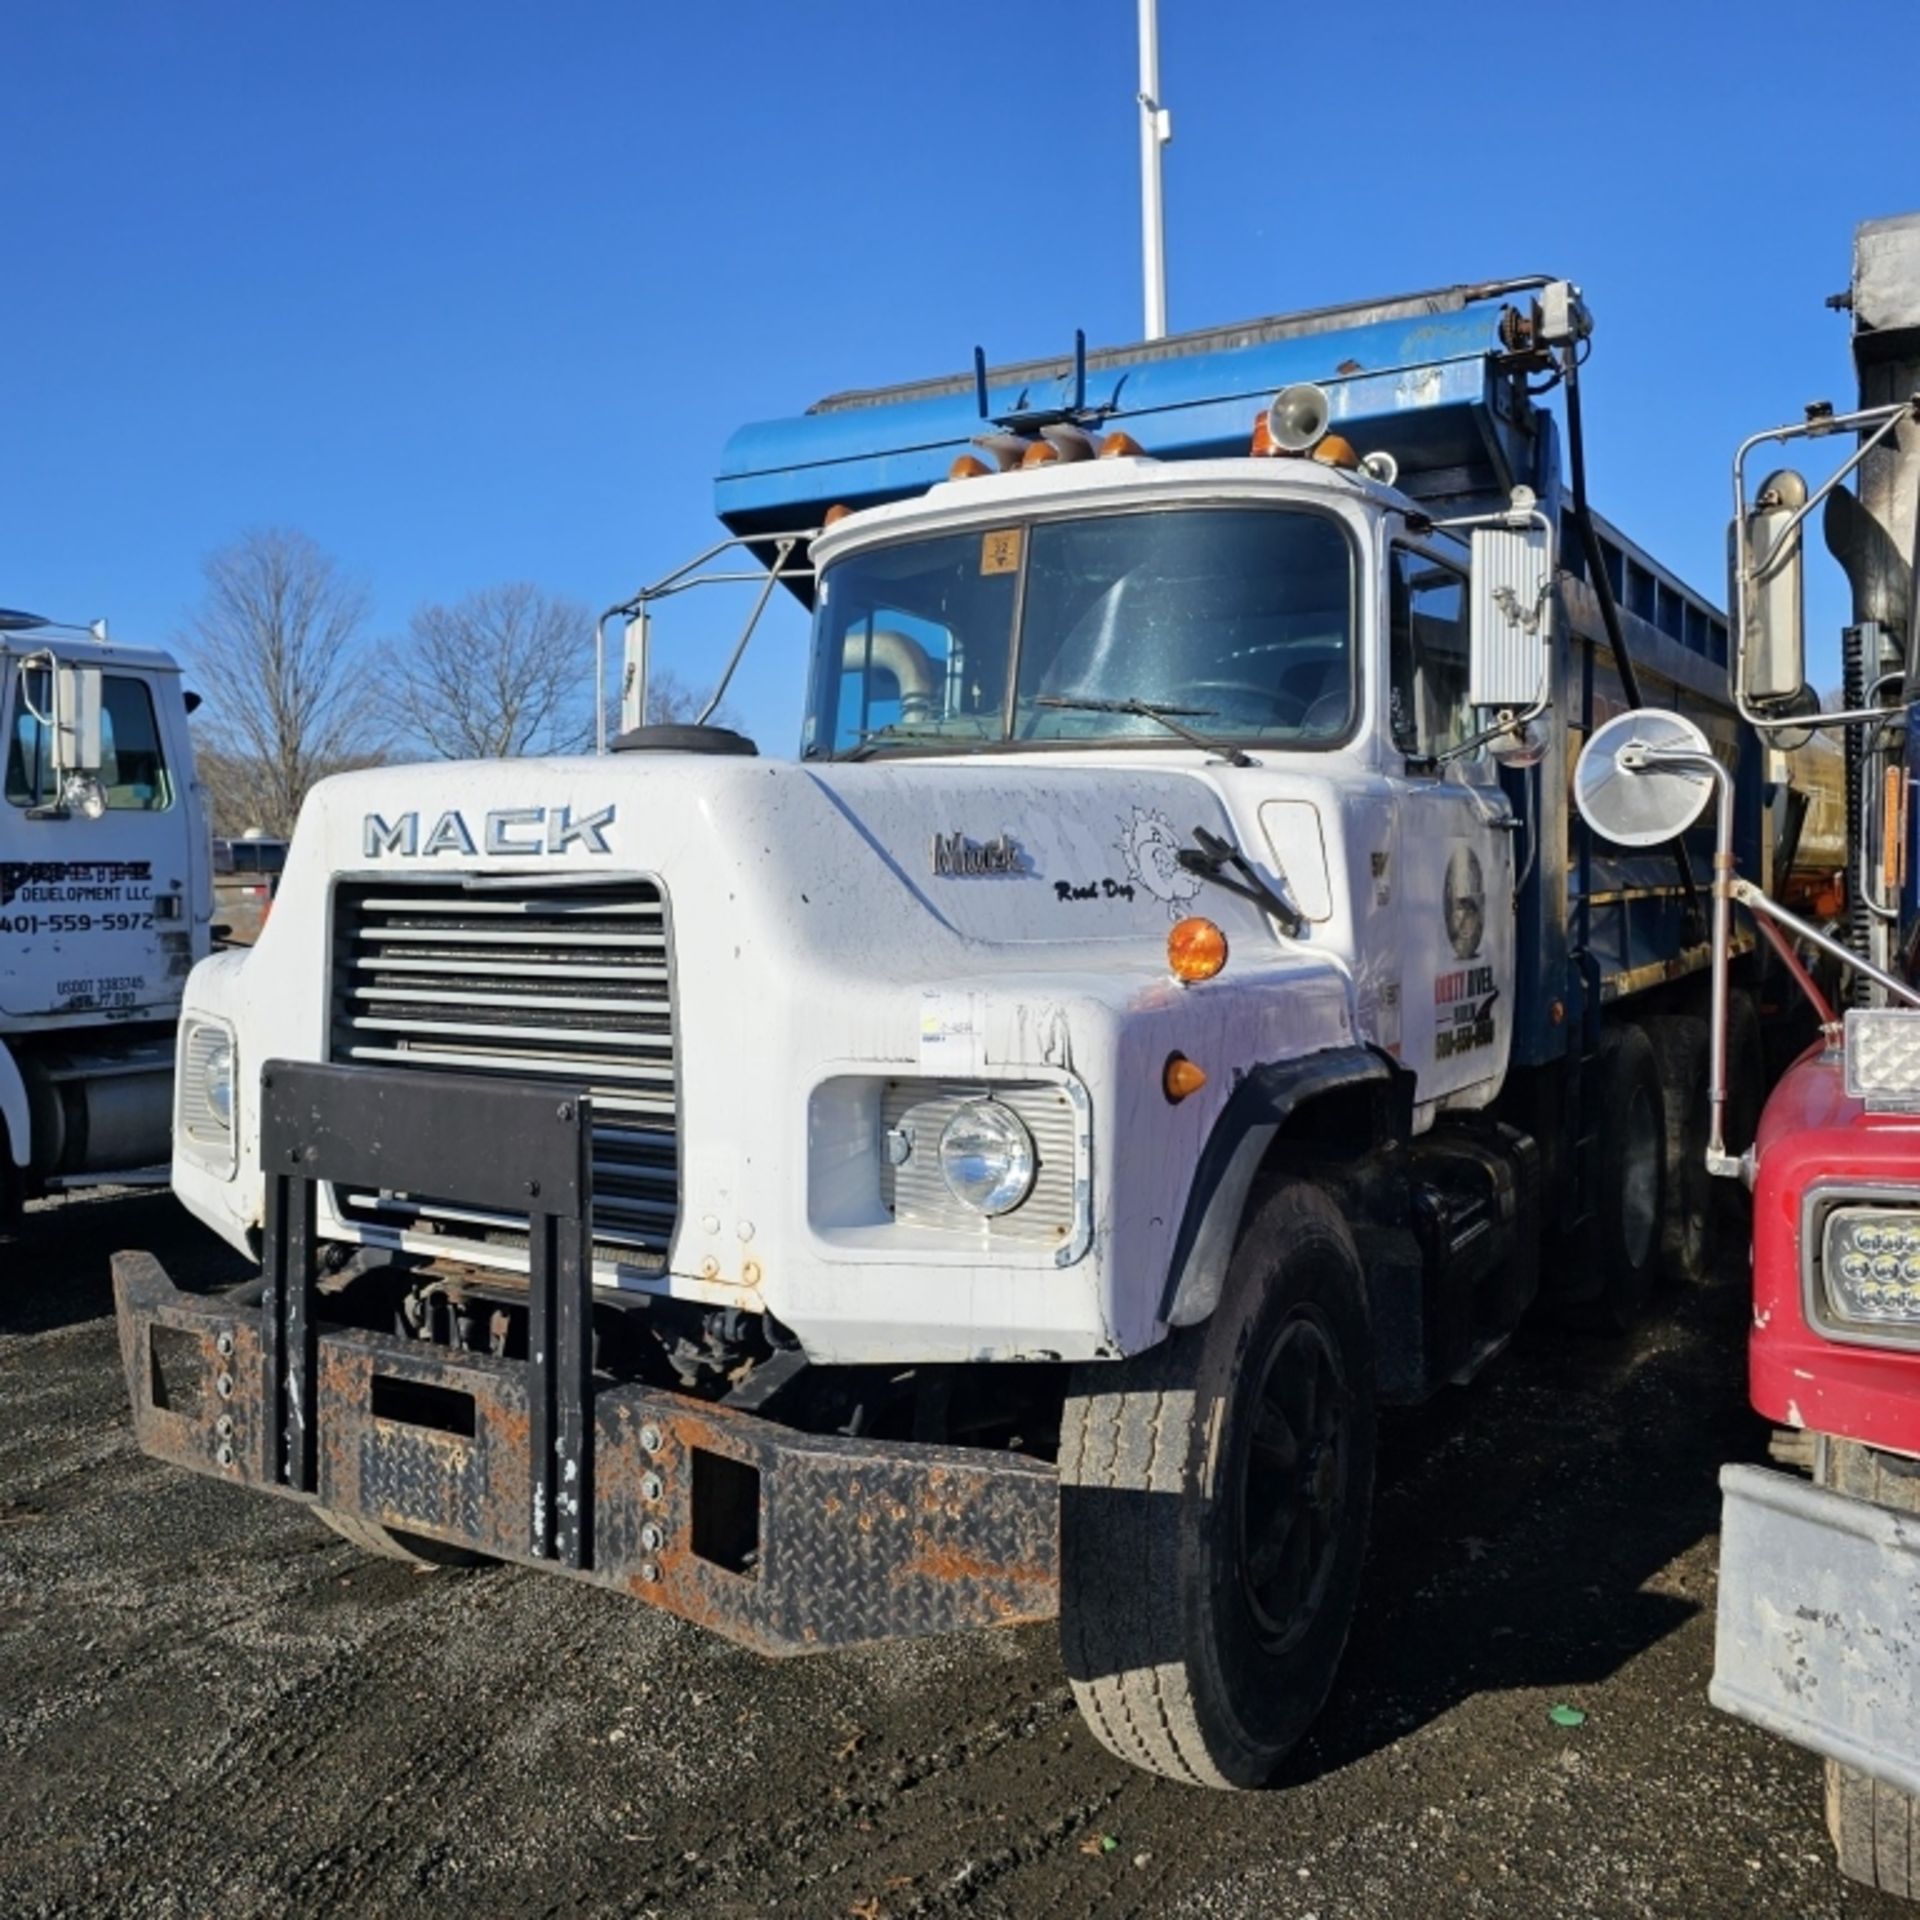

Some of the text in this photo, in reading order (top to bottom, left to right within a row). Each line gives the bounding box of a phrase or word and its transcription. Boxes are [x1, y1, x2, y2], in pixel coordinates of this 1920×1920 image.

[364, 804, 615, 858] MACK
[1054, 877, 1135, 902] Road Dog
[0, 913, 153, 934] 401-559-5972
